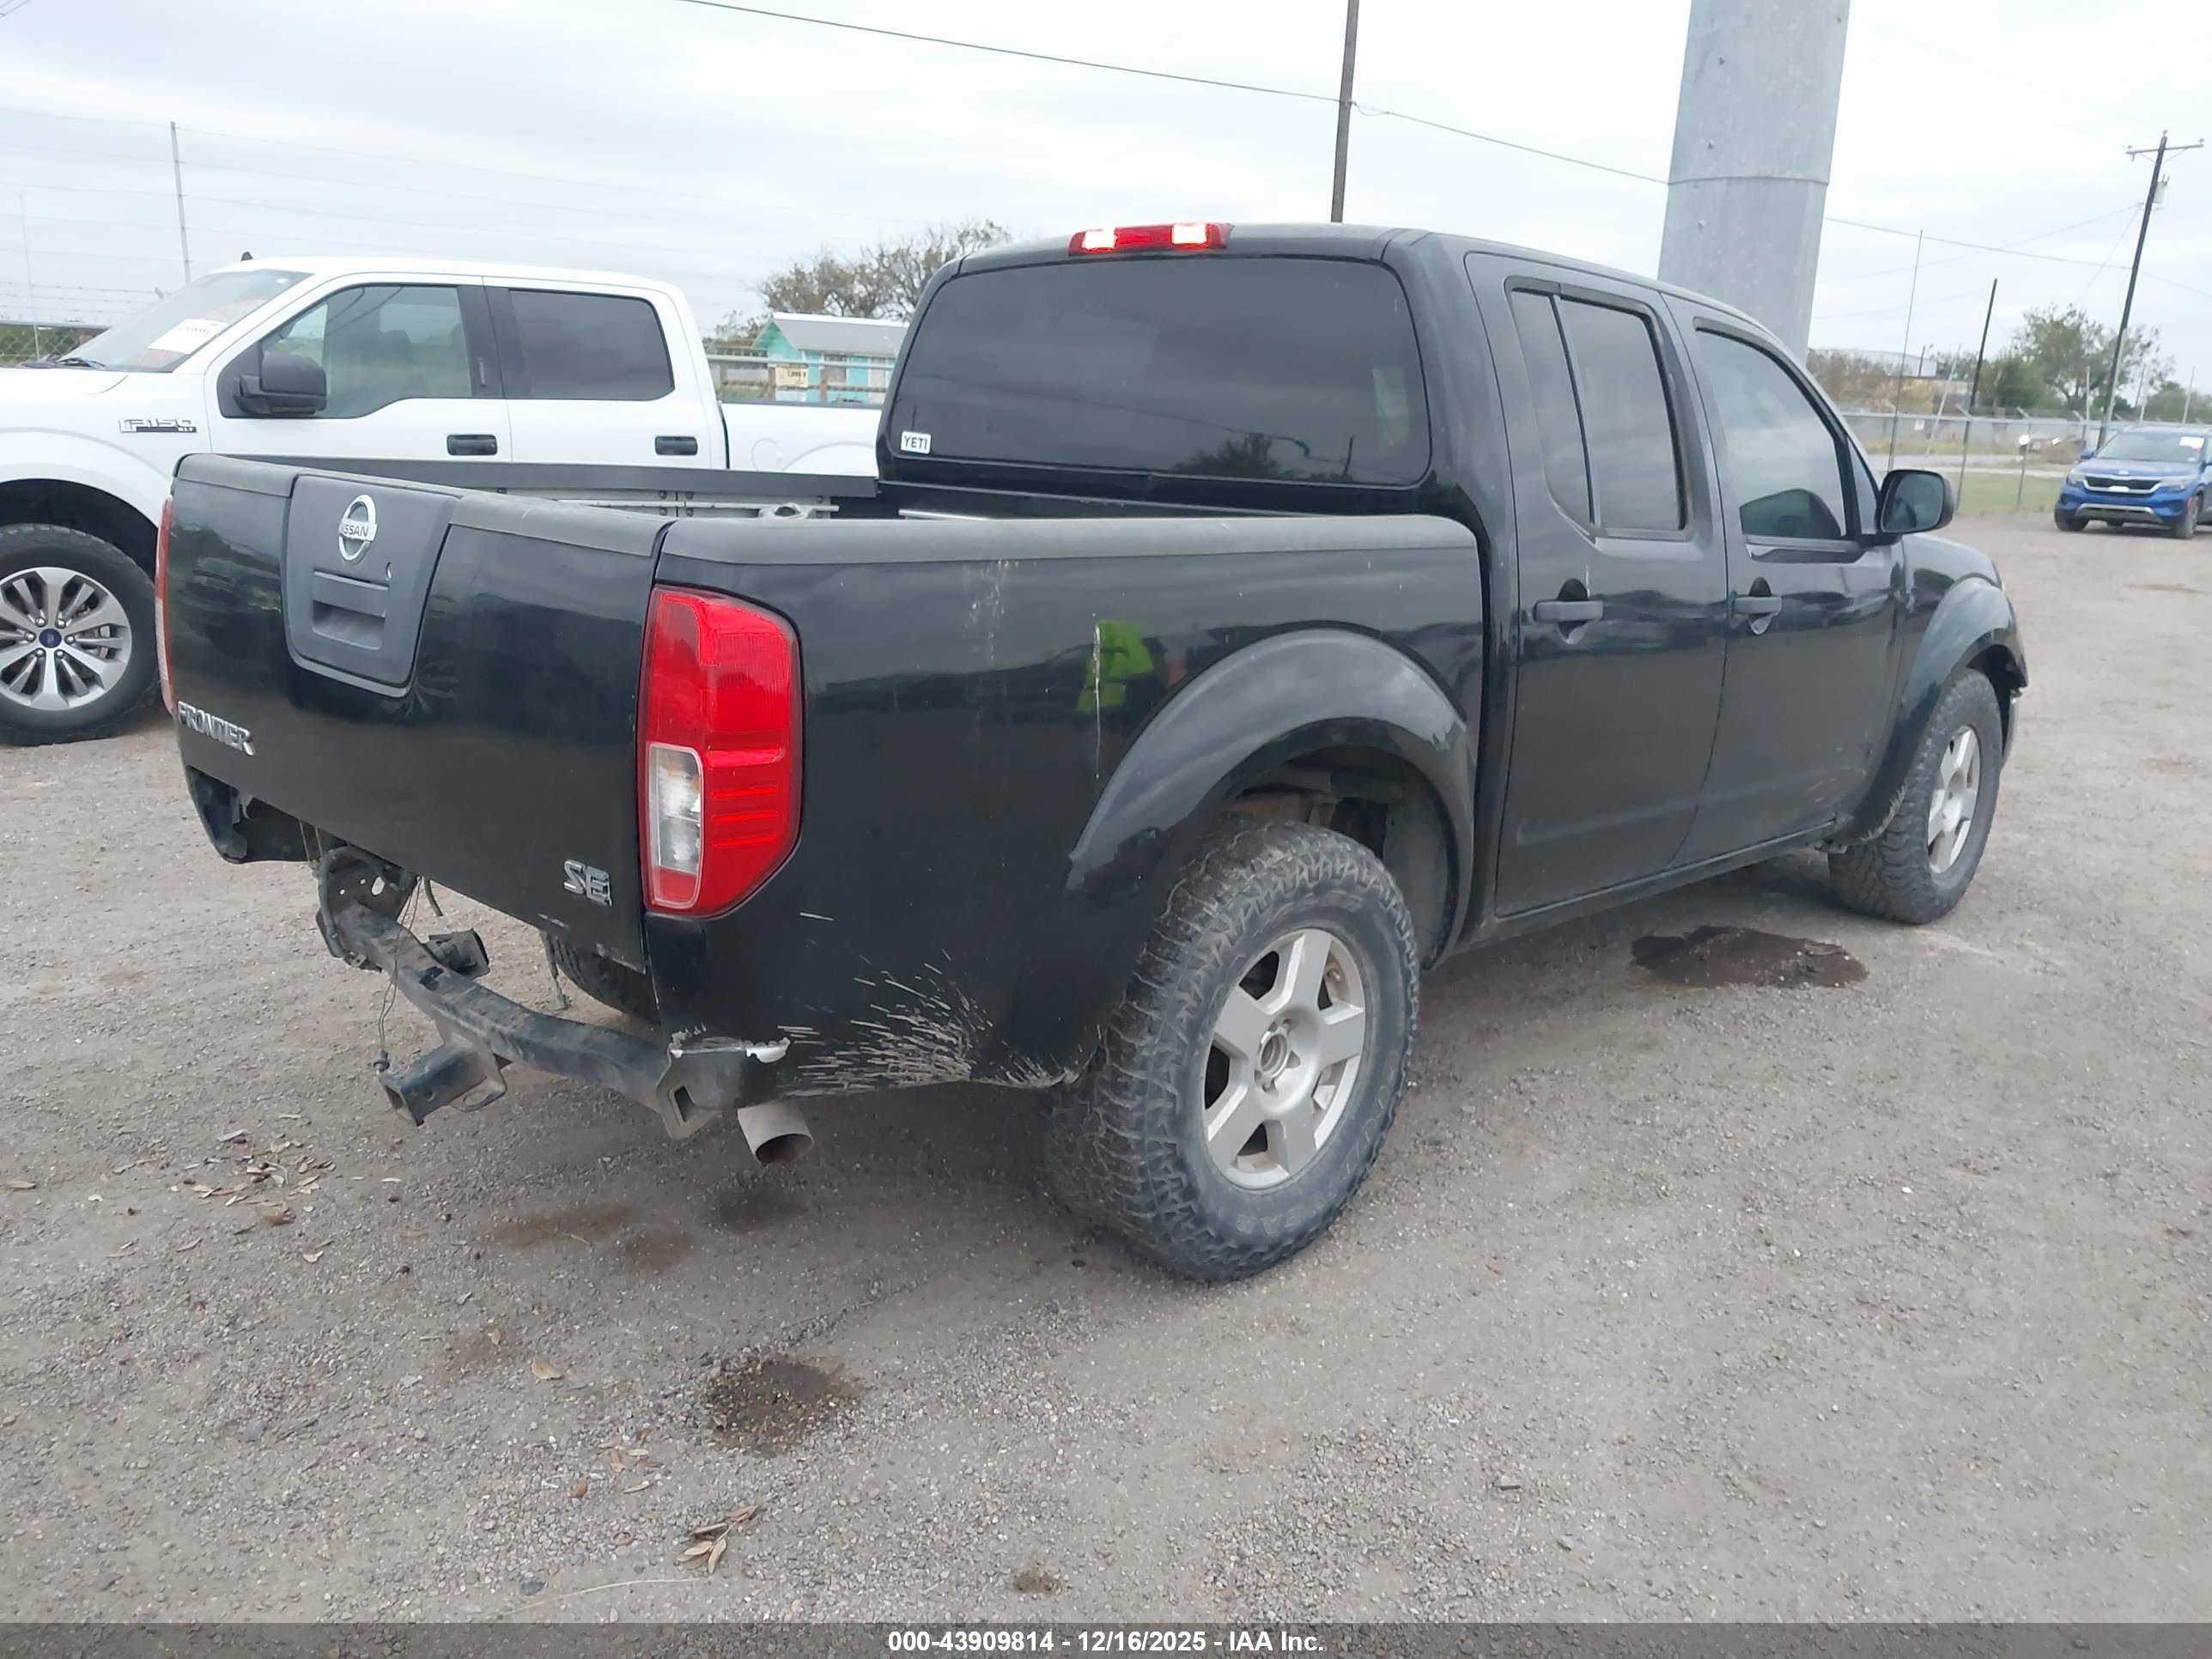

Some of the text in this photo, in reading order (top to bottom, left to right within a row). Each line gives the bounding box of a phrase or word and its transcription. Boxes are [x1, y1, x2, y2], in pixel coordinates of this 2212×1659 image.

[903, 435, 928, 450] YETI
[178, 700, 256, 756] FRONTIER
[563, 859, 612, 907] SE
